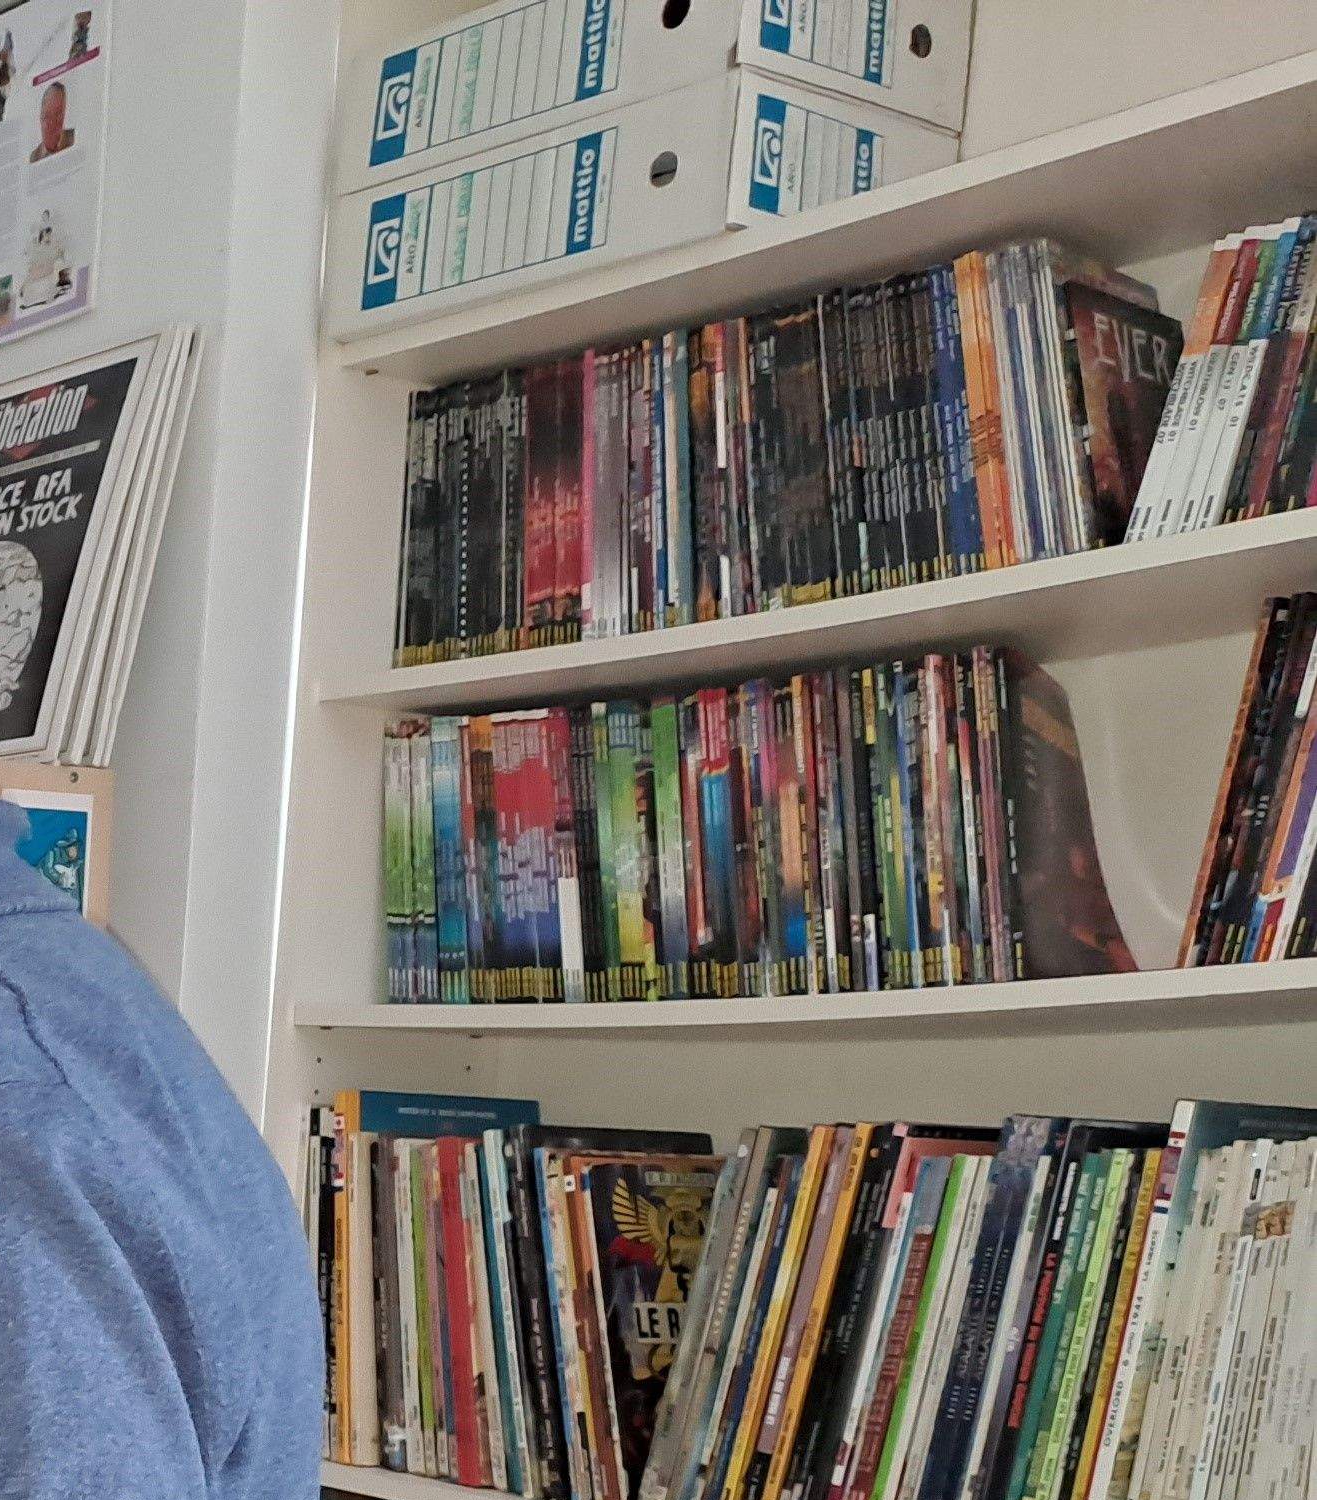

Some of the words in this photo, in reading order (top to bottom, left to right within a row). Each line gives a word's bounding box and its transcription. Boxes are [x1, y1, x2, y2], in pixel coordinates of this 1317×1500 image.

[574, 149, 596, 243] mattio
[34, 468, 74, 502] RFA
[16, 492, 84, 533] STOCK
[634, 1307, 660, 1338] LE
[1101, 1380, 1125, 1447] OVERLORD
